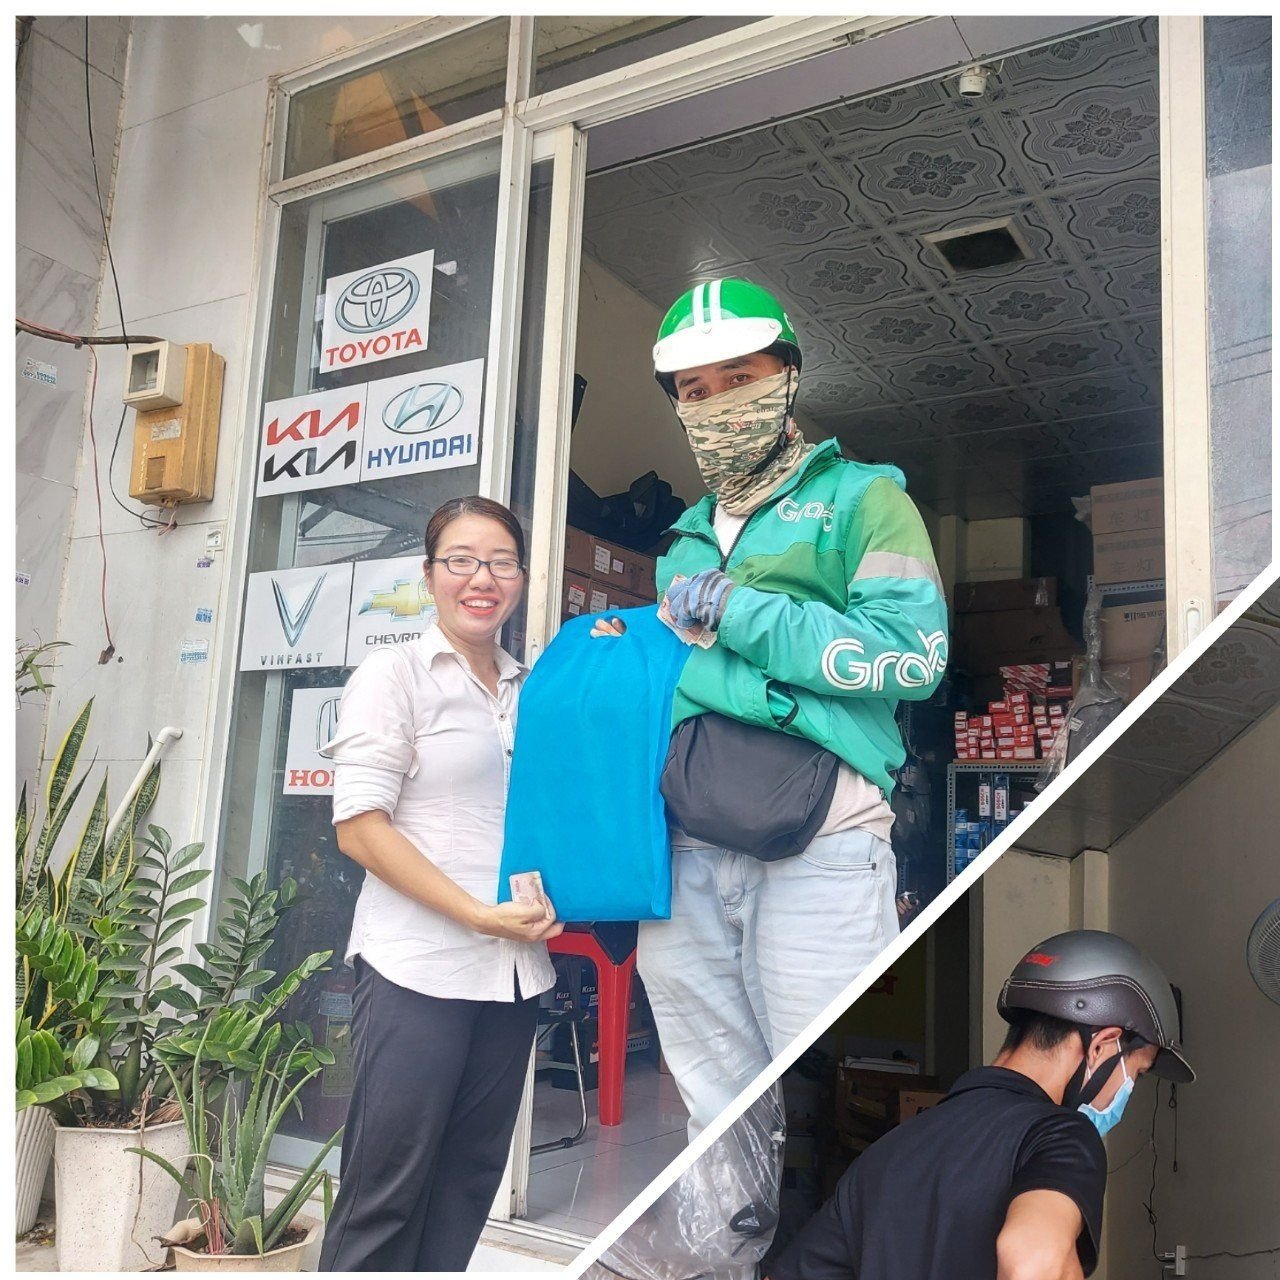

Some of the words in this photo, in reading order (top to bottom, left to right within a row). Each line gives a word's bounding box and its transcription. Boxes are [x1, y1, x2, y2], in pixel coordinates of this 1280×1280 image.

[326, 328, 423, 367] TOYOTA
[267, 402, 360, 446] KIA
[263, 439, 357, 483] KIA
[367, 433, 473, 469] HYUNDAI
[777, 498, 834, 533] Grab
[260, 652, 324, 667] VINFAST
[821, 629, 949, 693] Grab
